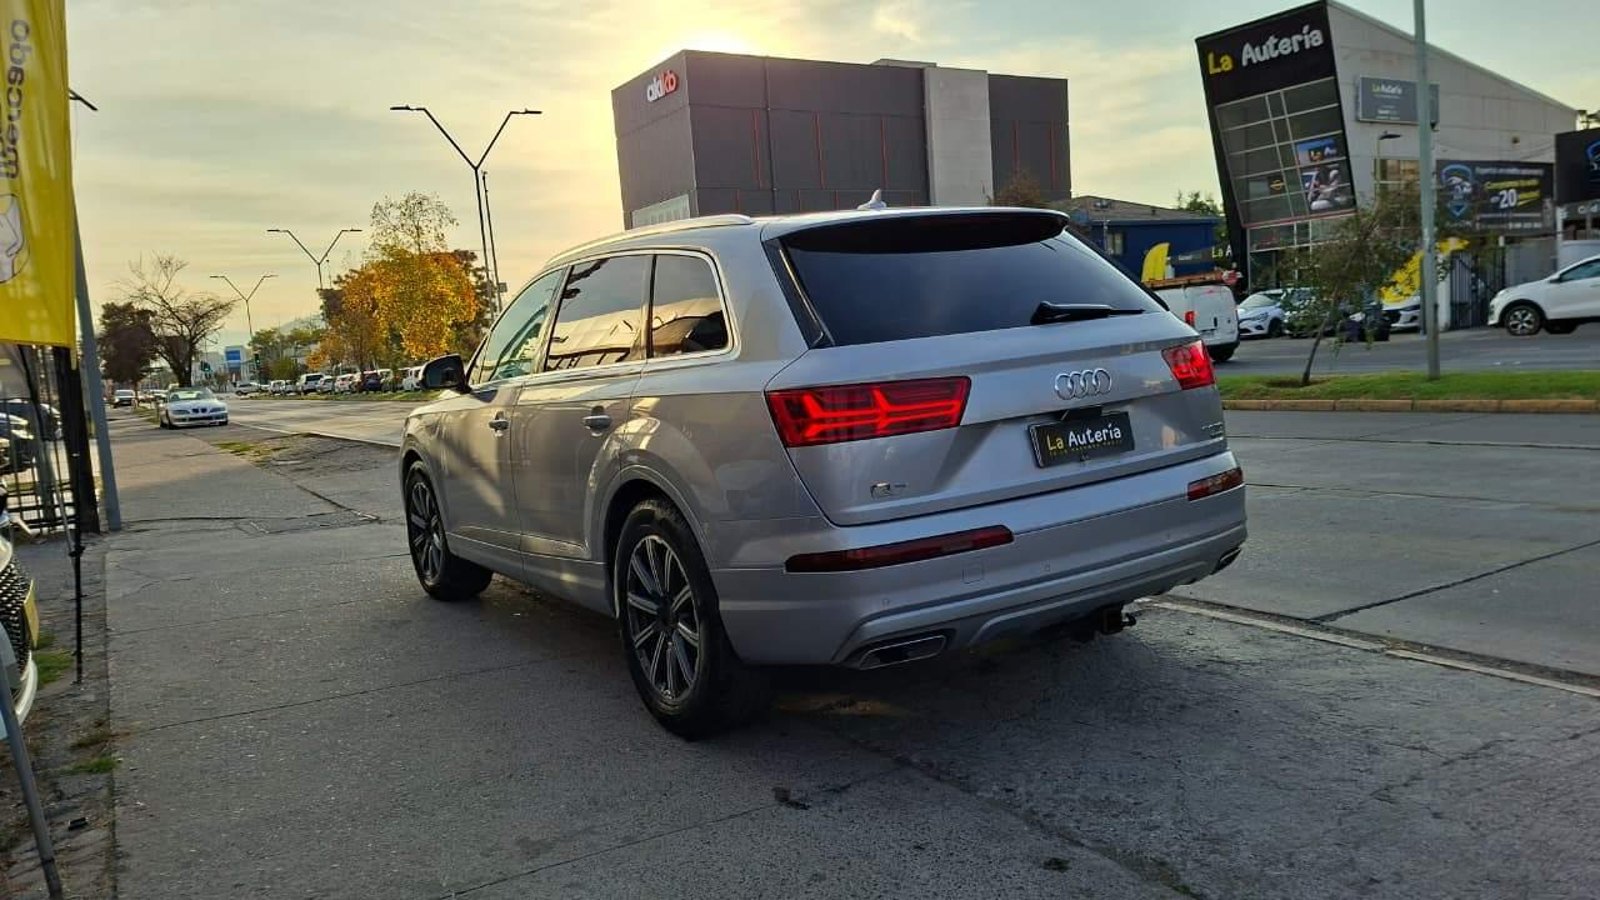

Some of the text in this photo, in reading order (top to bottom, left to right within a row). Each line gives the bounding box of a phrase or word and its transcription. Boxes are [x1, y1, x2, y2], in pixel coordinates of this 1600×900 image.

[1207, 24, 1324, 75] La Autería
[1046, 434, 1065, 451] La
[1068, 423, 1122, 448] Autería
